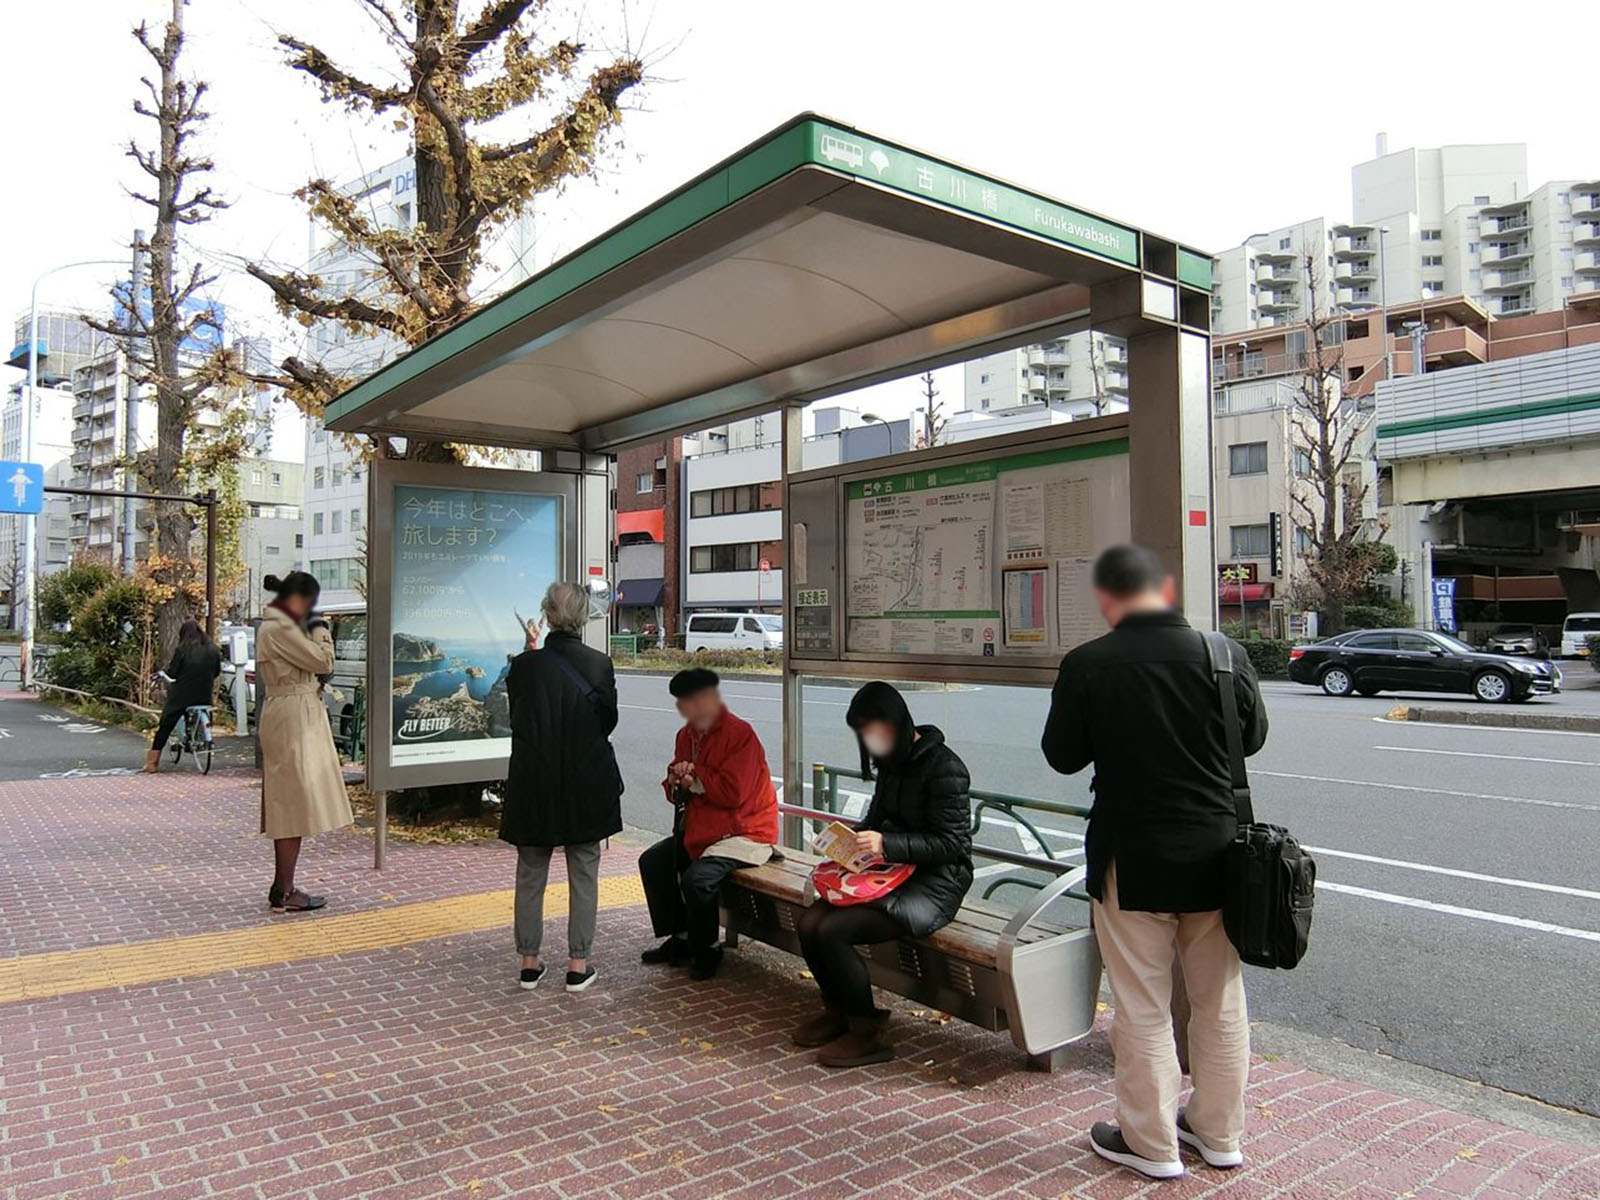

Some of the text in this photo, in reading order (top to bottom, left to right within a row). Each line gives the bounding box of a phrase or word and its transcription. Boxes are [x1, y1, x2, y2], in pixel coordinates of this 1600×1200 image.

[916, 166, 999, 213] 古川橋
[1034, 207, 1120, 251] Furukawabashi
[403, 716, 451, 733] FLY BETTER
